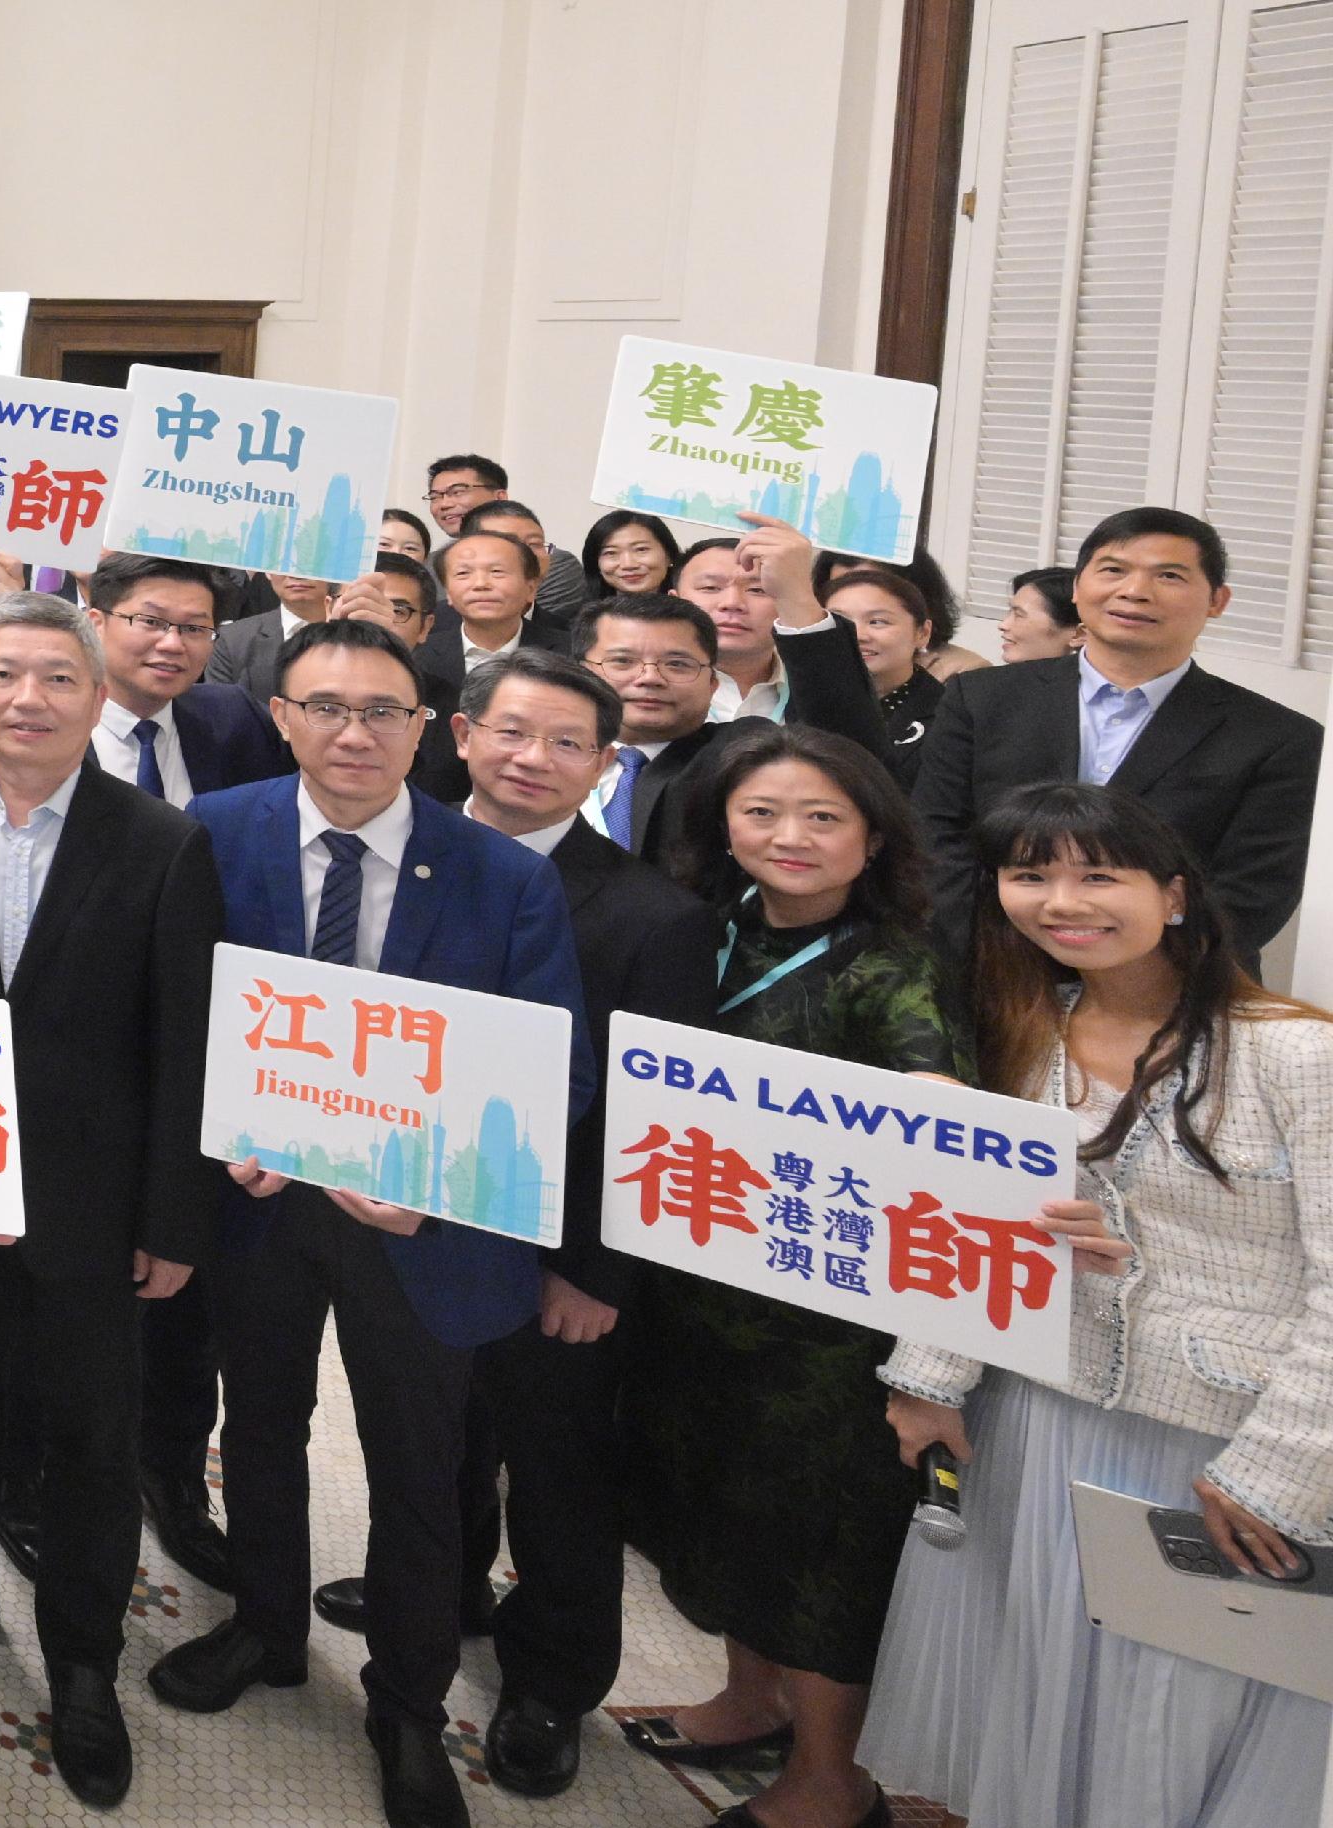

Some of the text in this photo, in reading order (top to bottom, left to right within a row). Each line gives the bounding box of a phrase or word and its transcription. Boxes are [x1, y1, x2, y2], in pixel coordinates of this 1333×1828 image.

[155, 392, 305, 472] 中山
[638, 362, 824, 450] 肇慶
[141, 468, 295, 508] Zhongshan
[648, 433, 803, 484] Zhaoqing
[240, 978, 447, 1095] 江門
[253, 1068, 422, 1129] Jiangmen
[621, 1047, 1058, 1177] GBA LAWYERS
